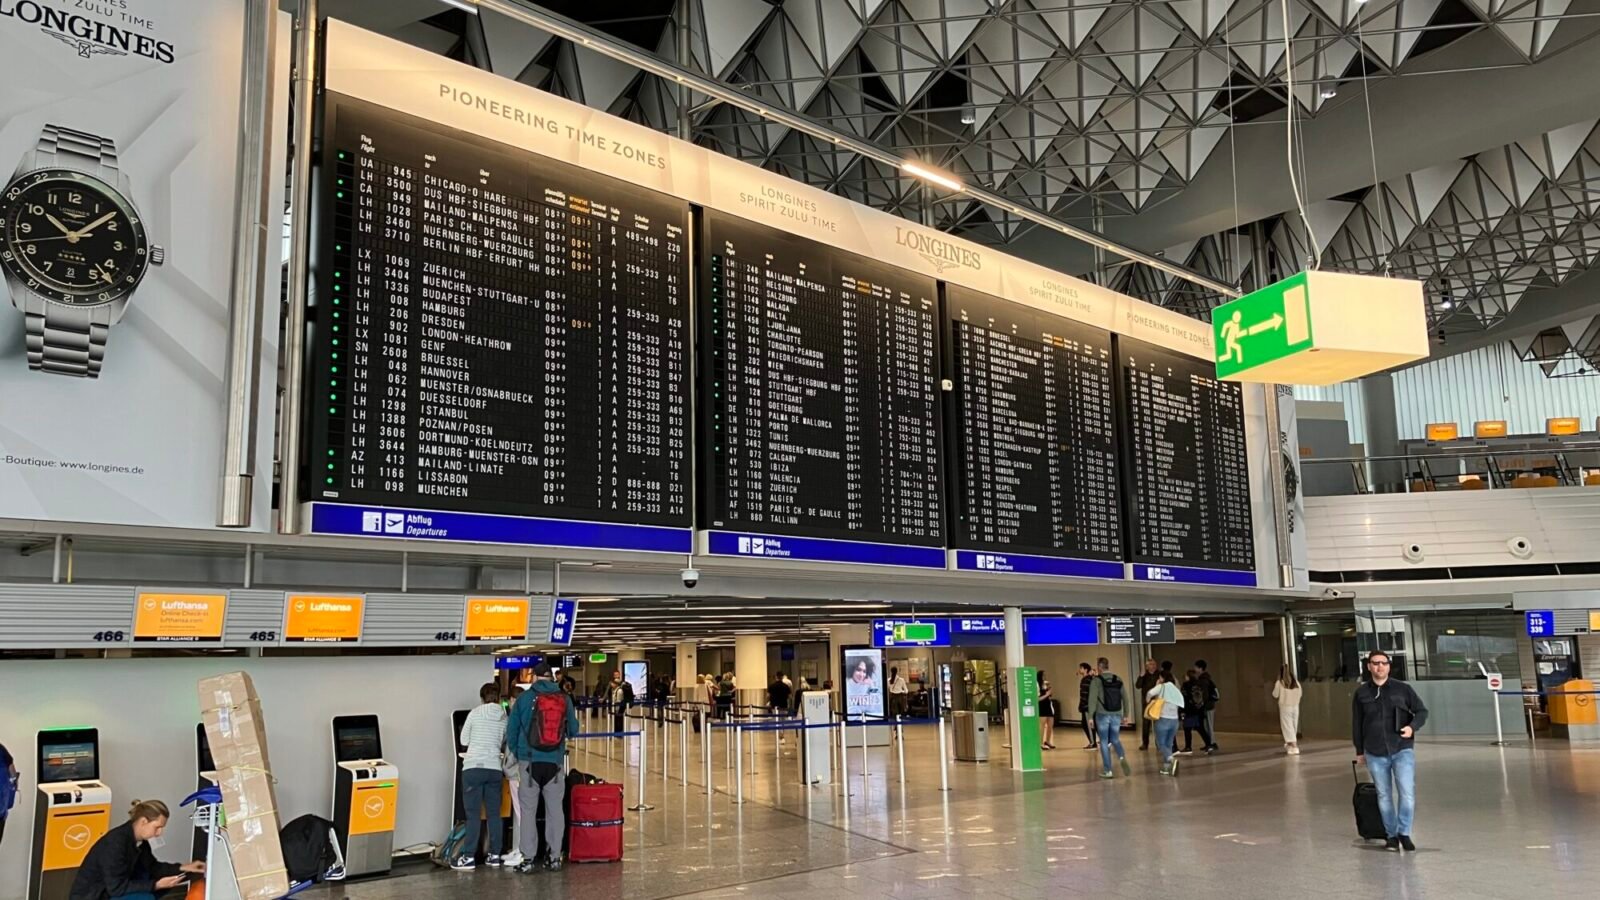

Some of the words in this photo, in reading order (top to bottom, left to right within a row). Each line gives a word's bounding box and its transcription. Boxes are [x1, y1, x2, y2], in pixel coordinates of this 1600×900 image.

[75, 0, 114, 17] ZULU
[120, 12, 154, 30] TIME
[439, 83, 559, 134] PIONEERING
[565, 125, 607, 150] TIME
[612, 141, 666, 170] ZONES
[34, 173, 48, 182] 22
[360, 157, 374, 169] UA
[393, 166, 412, 180] 945
[424, 175, 478, 198] CHICAGO-O
[484, 191, 506, 205] HARE
[7, 188, 21, 200] 20
[48, 194, 57, 204] 11
[68, 192, 82, 204] 12
[761, 185, 817, 212] LONGINES
[360, 183, 373, 195] CA
[393, 191, 411, 205] 949
[424, 199, 518, 232] MAILAND-MALPENSA
[387, 177, 411, 192] 3500
[424, 187, 442, 200] DUS
[448, 194, 518, 220] HBF-SIEGBURG
[524, 213, 539, 226] HBF
[28, 204, 44, 215] 10
[95, 204, 99, 213] 1
[739, 193, 775, 213] SPIRIT
[780, 203, 808, 223] ZULU
[813, 216, 837, 232] TIME
[21, 223, 32, 233] 9
[107, 221, 117, 231] 2
[387, 203, 411, 218] 1028
[424, 212, 454, 228] PARIS
[460, 221, 477, 234] CH.
[484, 227, 495, 238] DE
[501, 231, 534, 248] GAULLE
[386, 215, 410, 230] 3460
[423, 224, 534, 260] NUERNBERG-WUERZBURG
[26, 244, 37, 254] 8
[113, 241, 122, 251] 3
[385, 228, 410, 243] 3710
[423, 237, 460, 254] BERLIN
[466, 247, 523, 269] HBF-ERFURT
[529, 262, 540, 273] HH
[896, 226, 982, 270] LONGINES
[2, 250, 14, 262] 16
[43, 261, 53, 271] 7
[104, 259, 115, 268] 4
[358, 248, 371, 260] LX
[386, 254, 410, 268] 1069
[423, 262, 466, 281] ZUERICH
[67, 267, 75, 276] 23
[89, 269, 98, 279] 5
[27, 279, 40, 289] 14
[384, 267, 409, 281] 3404
[423, 275, 540, 308] MUENCHEN-STUTTGART-U
[766, 280, 796, 295] HELSINKI
[1042, 280, 1078, 299] LONGINES
[63, 294, 74, 303] 12
[98, 292, 110, 301] 10
[385, 280, 409, 294] 1336
[422, 288, 471, 306] BUDAPEST
[766, 290, 797, 305] SALZBURG
[1029, 286, 1053, 301] SPIRIT
[1054, 294, 1073, 307] ZULU
[1074, 300, 1091, 313] TIME
[390, 294, 409, 307] 008
[422, 301, 465, 318] HAMBURG
[766, 300, 790, 313] MALAGA
[390, 307, 409, 320] 206
[422, 313, 465, 331] DRESDEN
[767, 310, 786, 322] MALTA
[767, 320, 801, 335] LJUBLJANA
[1127, 312, 1170, 334] PIONEERING
[1172, 327, 1188, 340] TIME
[1189, 332, 1210, 346] ZONES
[356, 328, 368, 339] LX
[384, 332, 407, 346] 1081
[421, 339, 445, 352] GENF
[390, 320, 408, 333] 902
[422, 327, 512, 351] LONDON-HEATHROW
[767, 330, 801, 345] CHARLOTTE
[355, 341, 369, 353] SN
[382, 346, 408, 359] 2608
[421, 352, 469, 369] BRUESSEL
[768, 340, 824, 360] TORONTO-PEARSON
[768, 351, 824, 370] FRIEDRICHSHAFEN
[388, 360, 407, 372] 048
[421, 365, 470, 382] HANNOVER
[388, 373, 407, 385] 062
[420, 378, 533, 404] MUENSTER/OSNABRUECK
[388, 387, 406, 398] 074
[420, 391, 487, 410] DUESSELDORF
[768, 391, 802, 404] STUTTGART
[382, 399, 406, 412] 1298
[421, 404, 469, 420] ISTANBUL
[768, 401, 803, 415] GOETEBORG
[381, 412, 406, 425] 1388
[419, 417, 493, 436] POZNAN/POSEN
[769, 421, 788, 432] PORTO
[380, 426, 405, 439] 3606
[419, 431, 533, 453] DORTMUND-KOELNDEUTZ
[769, 432, 788, 442] TUNIS
[379, 440, 405, 452] 3644
[418, 444, 538, 466] HAMBURG-MUENSTER-OSN
[769, 452, 796, 464] CALGARY
[60, 462, 144, 474] www.longines.de
[351, 450, 365, 461] AZ
[386, 454, 405, 465] 413
[418, 457, 503, 475] MAILAND-LINATE
[770, 463, 789, 473] IBIZA
[380, 467, 404, 479] 1166
[418, 470, 468, 485] LISSABON
[770, 473, 801, 484] VALENCIA
[385, 481, 404, 492] 098
[418, 484, 468, 498] MUENCHEN
[770, 494, 794, 504] ALGIER
[407, 514, 432, 526] Abflug
[771, 515, 798, 525] TALLINN
[407, 525, 447, 537] Departures
[765, 539, 781, 548] Abflug
[765, 547, 790, 556] Departures
[161, 601, 208, 609] Lufthansa
[310, 602, 352, 612] Lufthansa
[485, 605, 520, 613] Lufthansa
[94, 630, 123, 642] 466
[250, 631, 275, 641] 465
[435, 632, 456, 640] 464
